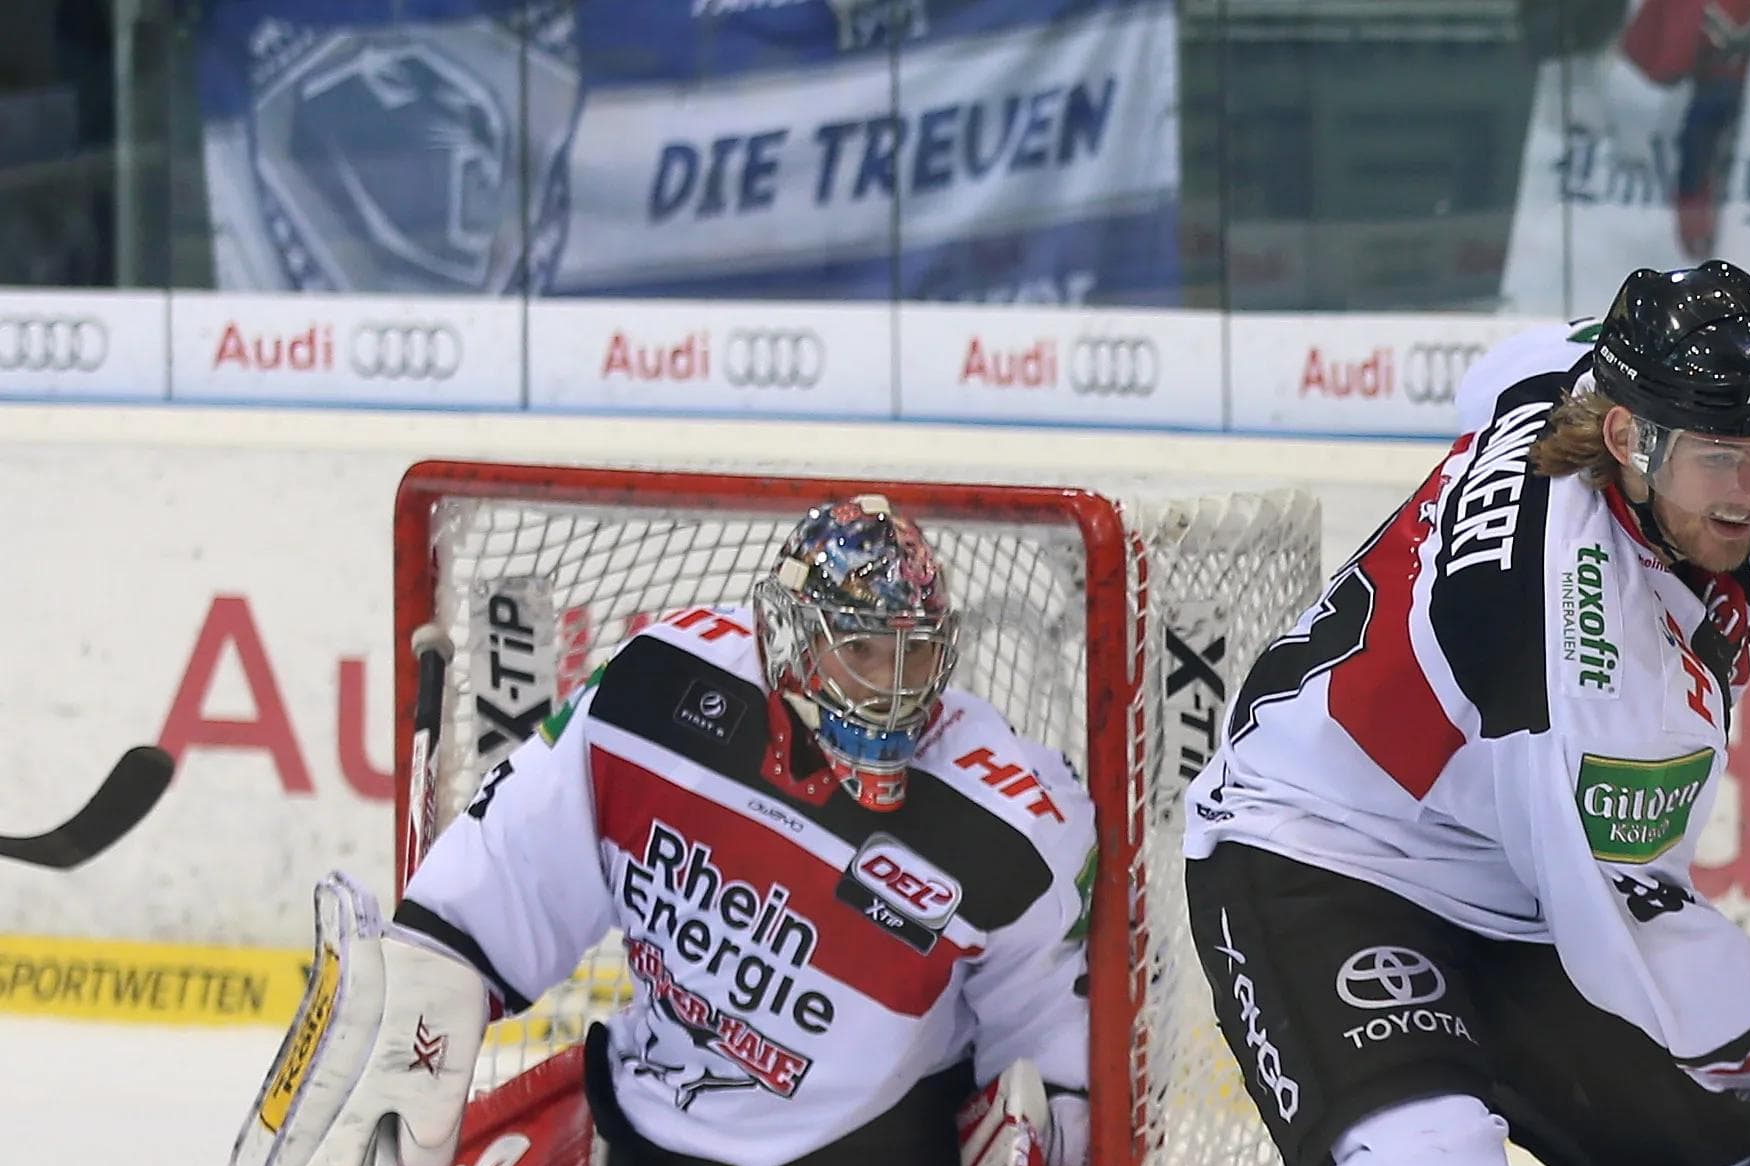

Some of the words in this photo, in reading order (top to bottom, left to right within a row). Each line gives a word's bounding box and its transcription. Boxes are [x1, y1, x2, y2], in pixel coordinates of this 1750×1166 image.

[649, 128, 790, 224] DIE
[814, 77, 1117, 205] TREUEN
[213, 322, 335, 371] Audi
[601, 332, 711, 382] Audi
[960, 338, 1058, 388] Audi
[1302, 348, 1396, 397] Audi
[1561, 571, 1577, 661] MINERALIEN
[1577, 543, 1620, 690] taxofit
[953, 746, 1067, 824] HIT
[1584, 780, 1700, 820] Gilden
[645, 822, 814, 968] Rhein
[623, 858, 835, 1034] Energie
[0, 955, 268, 1015] PORTWETTEN
[716, 1013, 812, 1097] HAIE
[1343, 1008, 1471, 1049] TOYOTA
